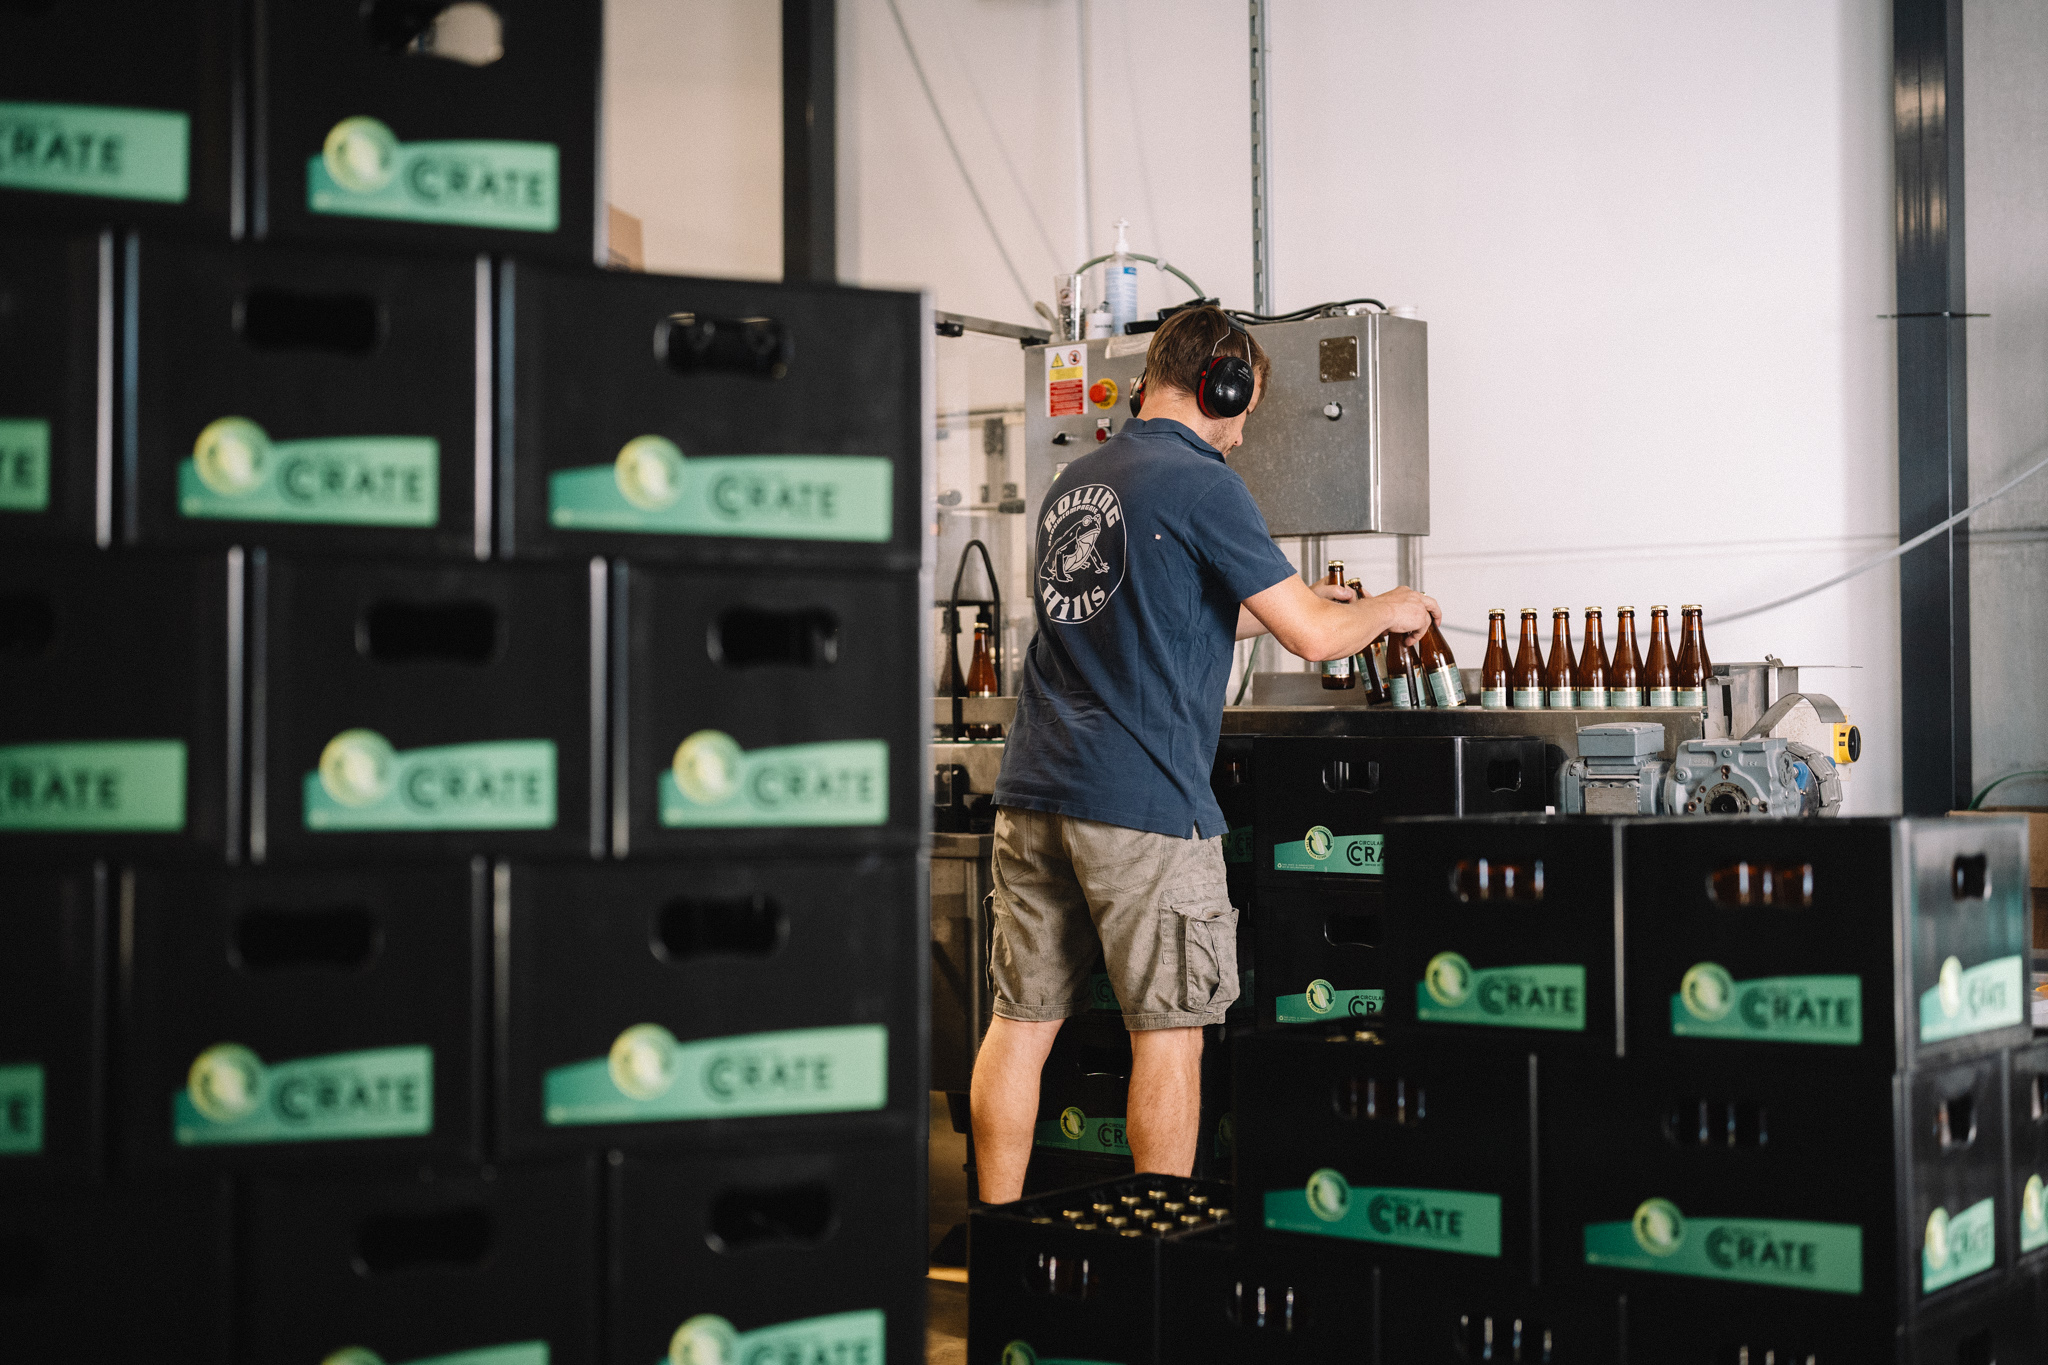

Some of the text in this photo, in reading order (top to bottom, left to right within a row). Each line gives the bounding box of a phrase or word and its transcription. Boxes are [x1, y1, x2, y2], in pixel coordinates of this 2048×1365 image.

[0, 123, 123, 176] RATE
[406, 155, 547, 207] CRATE
[279, 455, 426, 505] CRATE
[708, 473, 836, 523] CRATE
[1044, 487, 1121, 533] ROLLING
[0, 764, 121, 812] RATE
[402, 764, 543, 814] CRATE
[749, 766, 874, 811] CRATE
[1477, 975, 1577, 1017] CRATE
[1738, 987, 1854, 1031] CRATE
[270, 1074, 419, 1126] CRATE
[702, 1054, 834, 1104] CRATE
[1366, 1193, 1463, 1240] CRATE
[1703, 1225, 1819, 1276] CRATE
